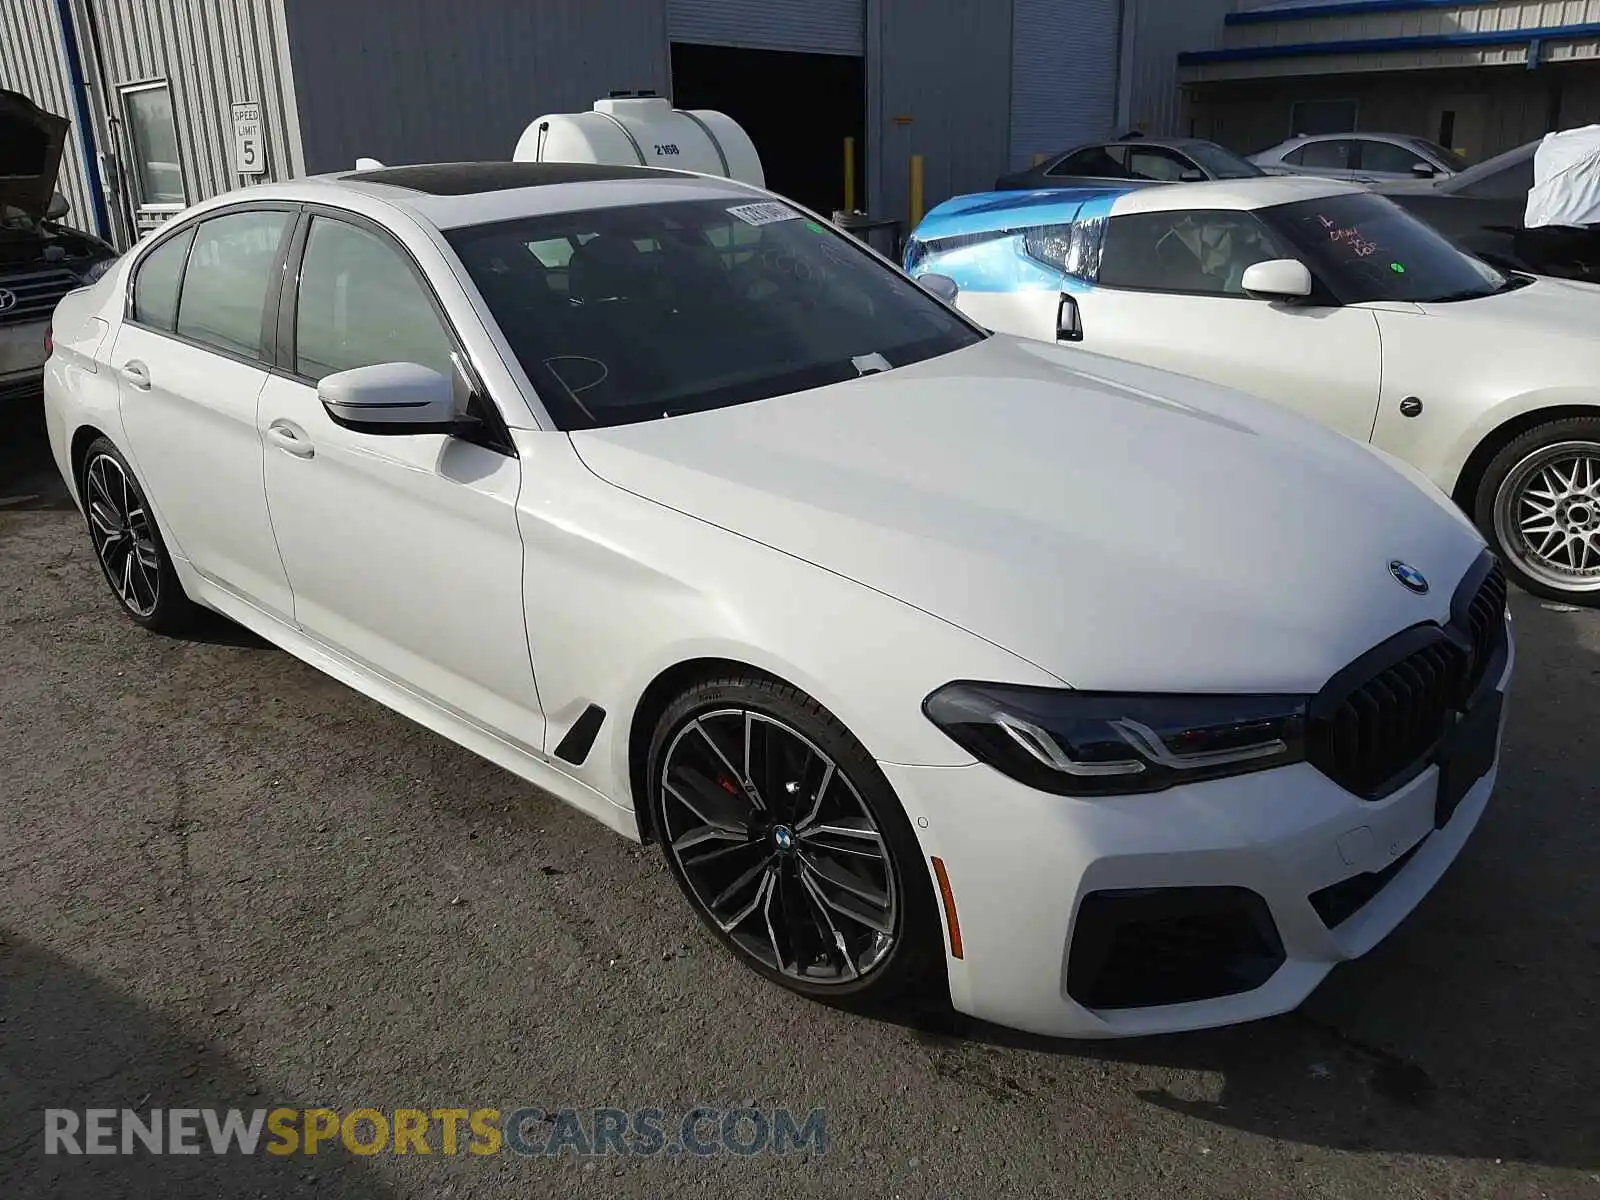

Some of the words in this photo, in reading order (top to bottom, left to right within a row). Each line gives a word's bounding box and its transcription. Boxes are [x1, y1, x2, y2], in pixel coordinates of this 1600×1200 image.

[234, 110, 259, 121] SPEED
[238, 125, 257, 137] LIMIT
[243, 140, 255, 165] 5
